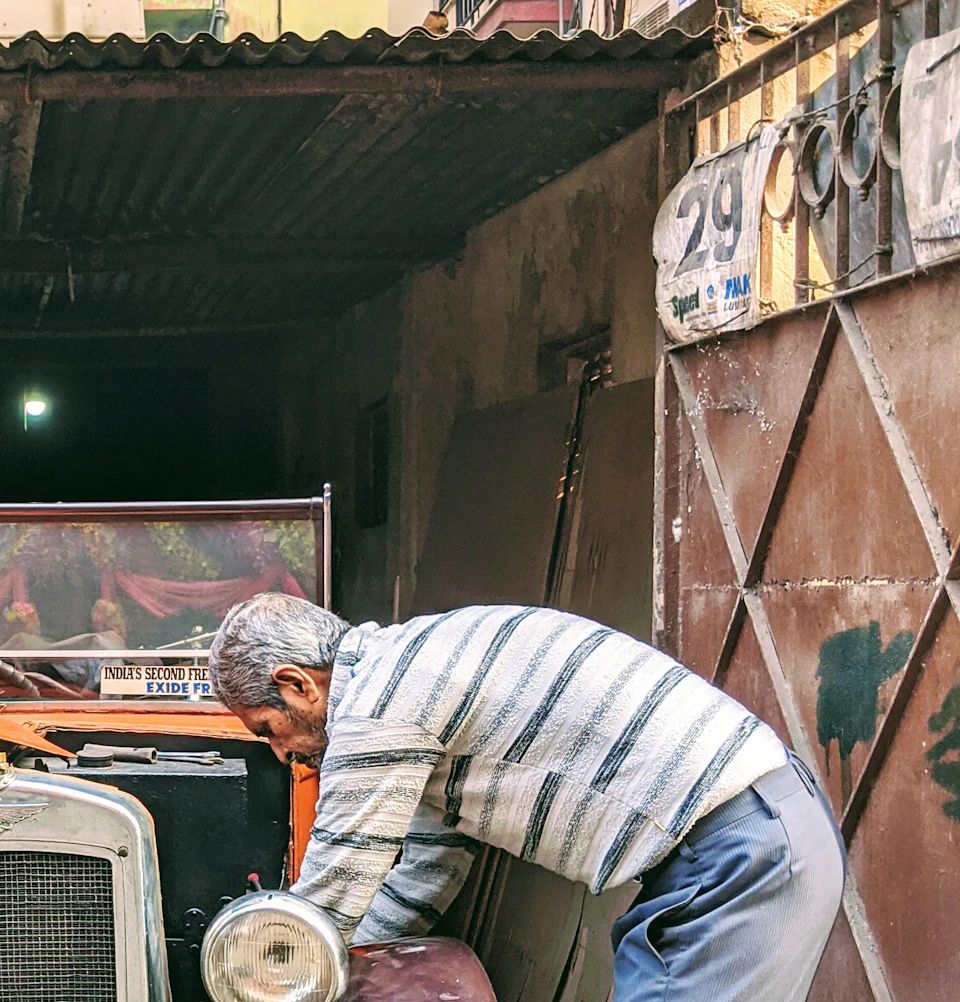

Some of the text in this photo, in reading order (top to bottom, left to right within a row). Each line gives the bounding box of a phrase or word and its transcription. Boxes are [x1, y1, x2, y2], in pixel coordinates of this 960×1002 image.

[675, 166, 743, 277] 29
[104, 666, 210, 681] INDIA'S SECOND FRE
[146, 681, 211, 695] EXIDE FR
